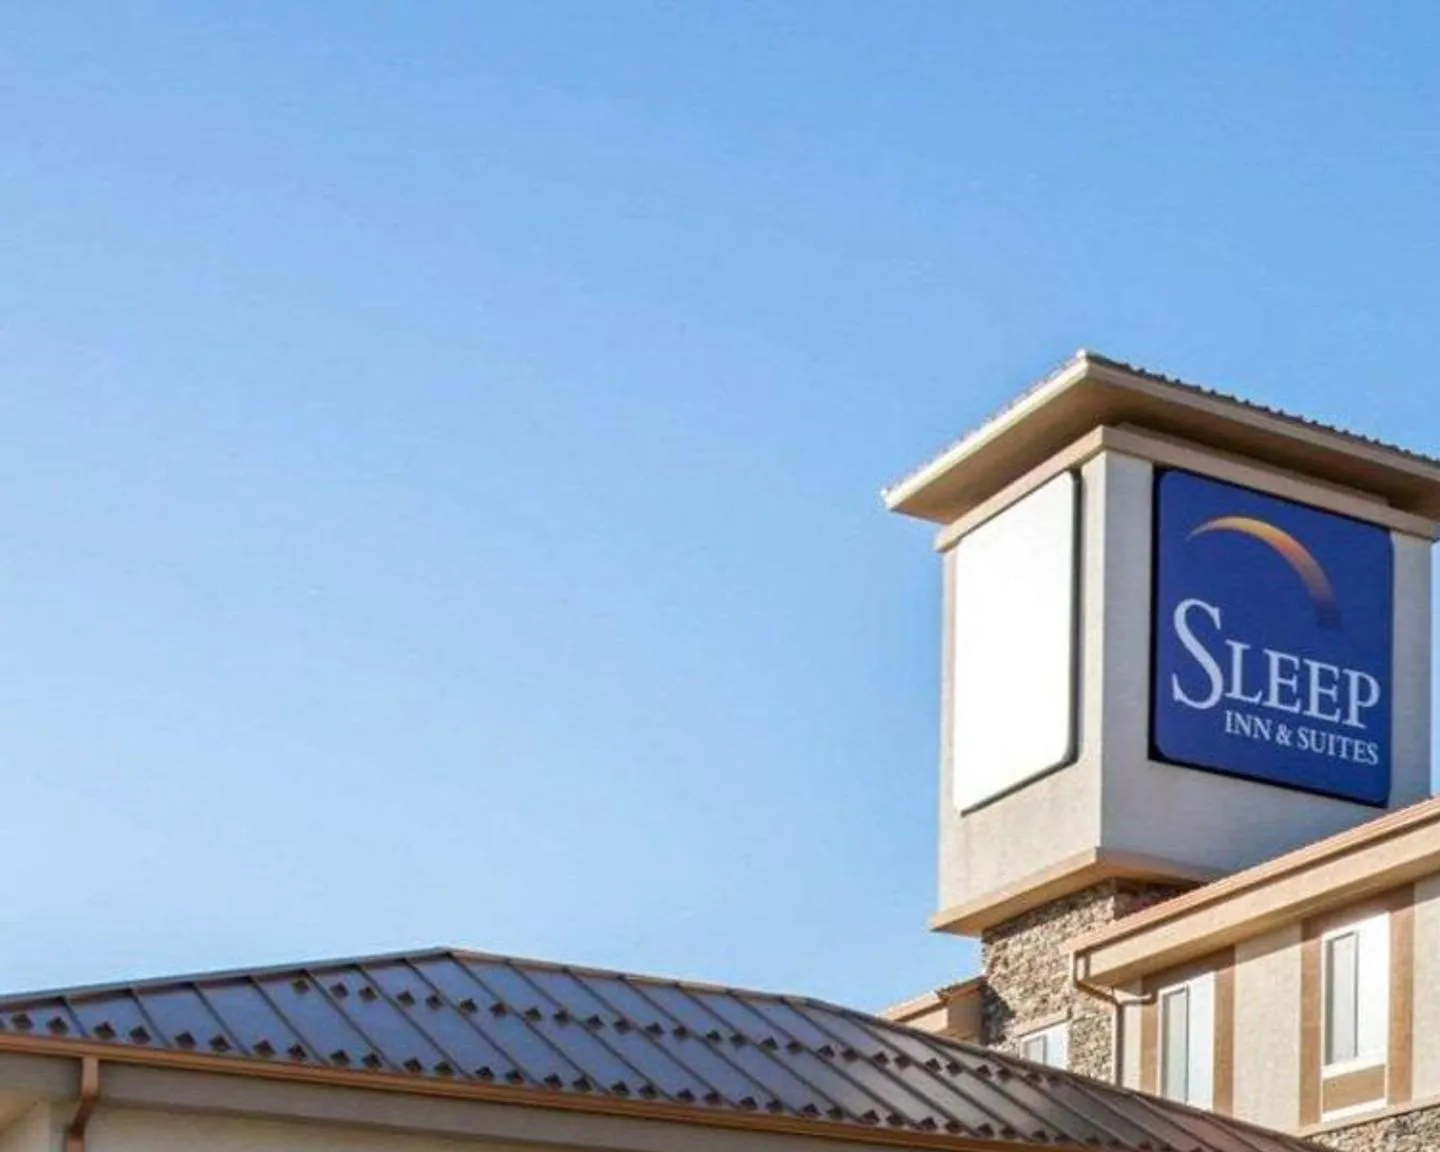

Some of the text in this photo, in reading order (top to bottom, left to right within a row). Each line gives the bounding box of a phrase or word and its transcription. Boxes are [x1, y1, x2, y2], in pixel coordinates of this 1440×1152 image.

[1172, 598, 1381, 730] SLEEP
[1225, 710, 1379, 766] INN & SUITES
